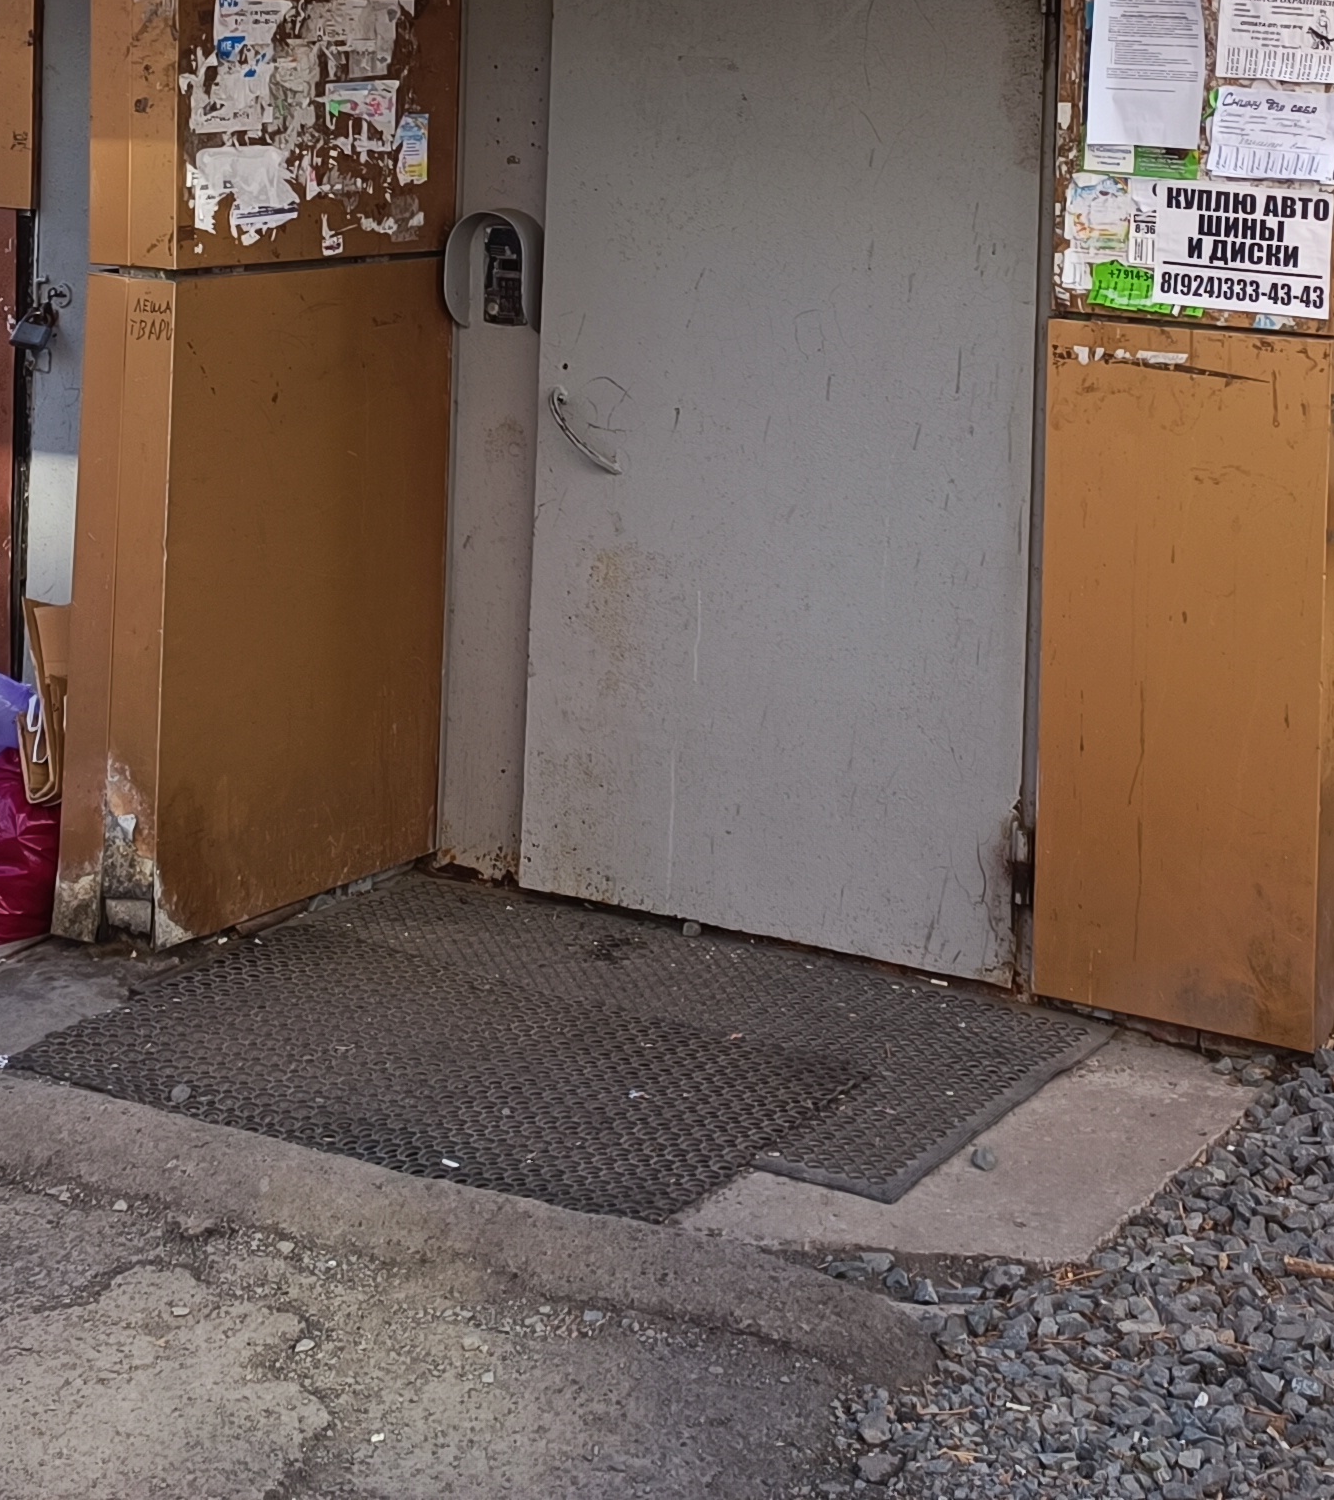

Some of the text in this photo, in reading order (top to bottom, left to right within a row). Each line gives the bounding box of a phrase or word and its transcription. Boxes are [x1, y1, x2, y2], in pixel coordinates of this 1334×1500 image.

[1167, 187, 1330, 221] КУПЛЮ АВТО
[1198, 214, 1285, 243] ШИНЫ
[1188, 237, 1299, 268] И ДИСКИ
[1108, 269, 1121, 279] +7
[1160, 271, 1325, 309] 8(924)333-43-43
